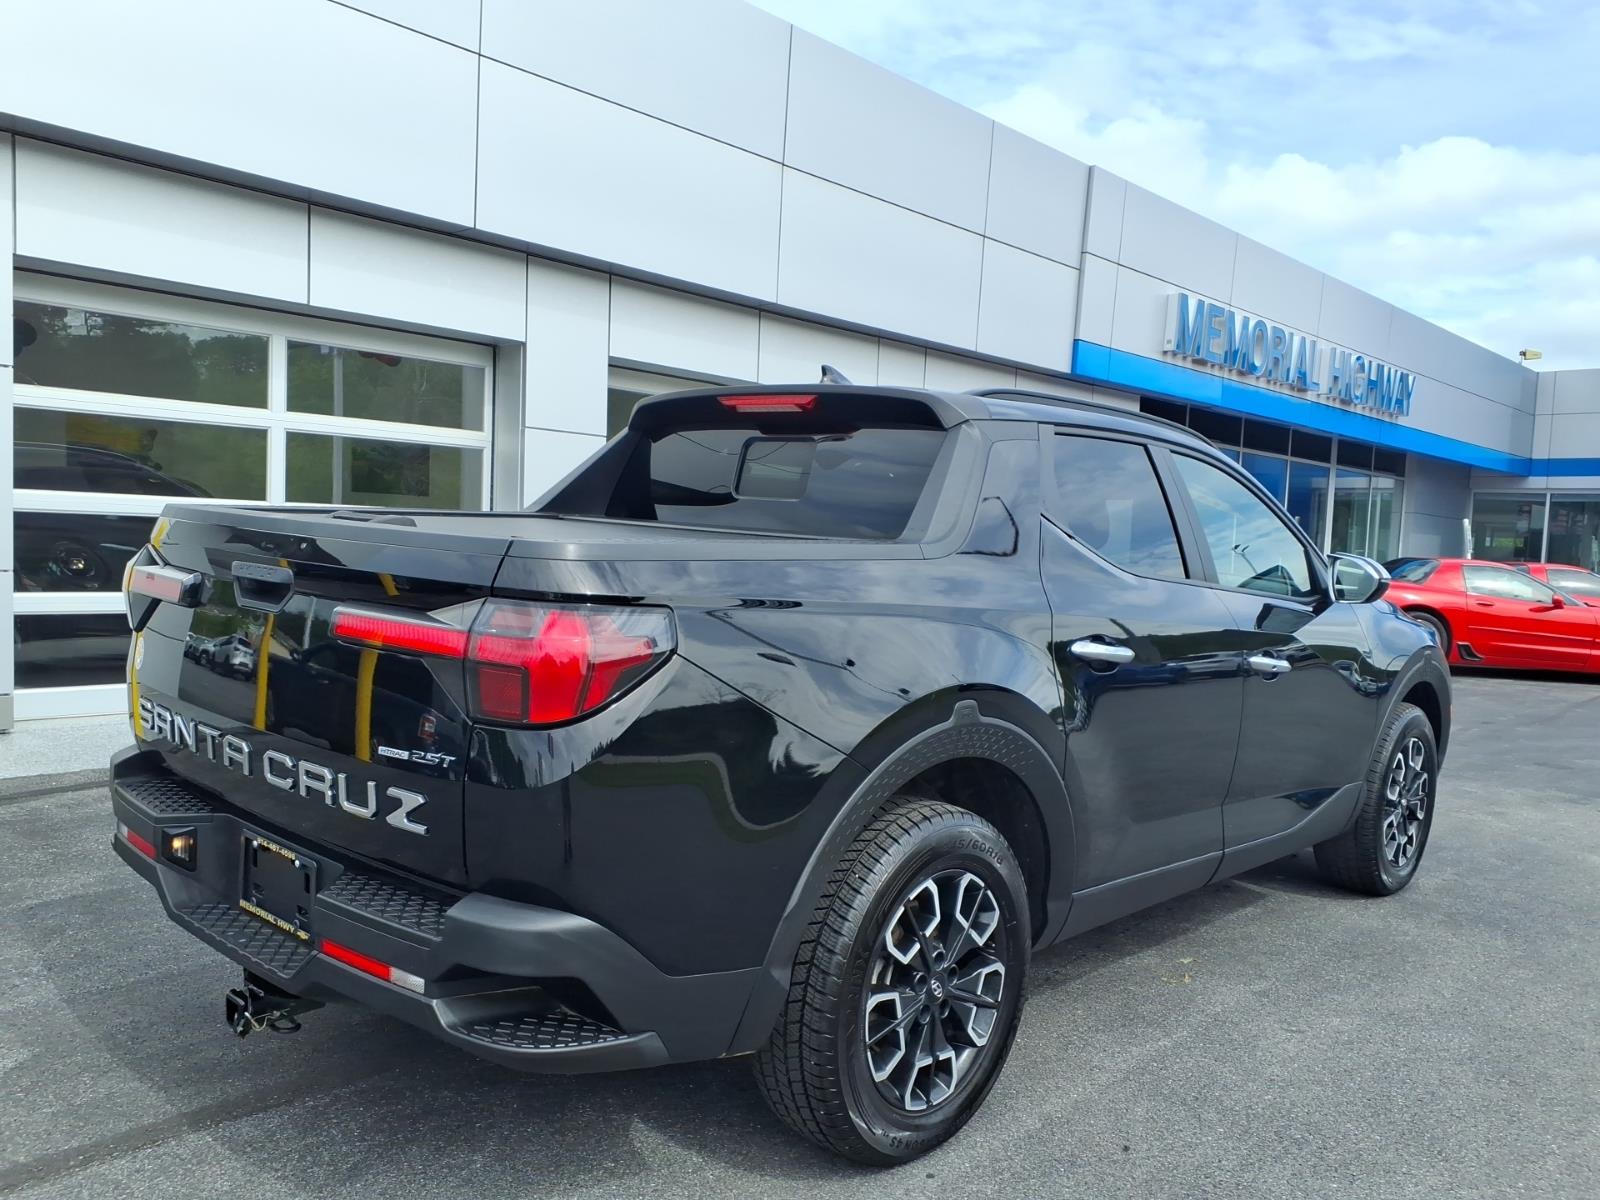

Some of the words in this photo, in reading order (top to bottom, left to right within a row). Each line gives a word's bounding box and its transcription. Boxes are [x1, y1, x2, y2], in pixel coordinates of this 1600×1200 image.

[1166, 292, 1320, 393] MEMORIAL
[1324, 346, 1416, 417] HIGHWAY
[138, 695, 253, 776] SANTA
[263, 749, 430, 836] CRUZ
[240, 899, 276, 925] MEMORIAL
[277, 918, 295, 932] HWY
